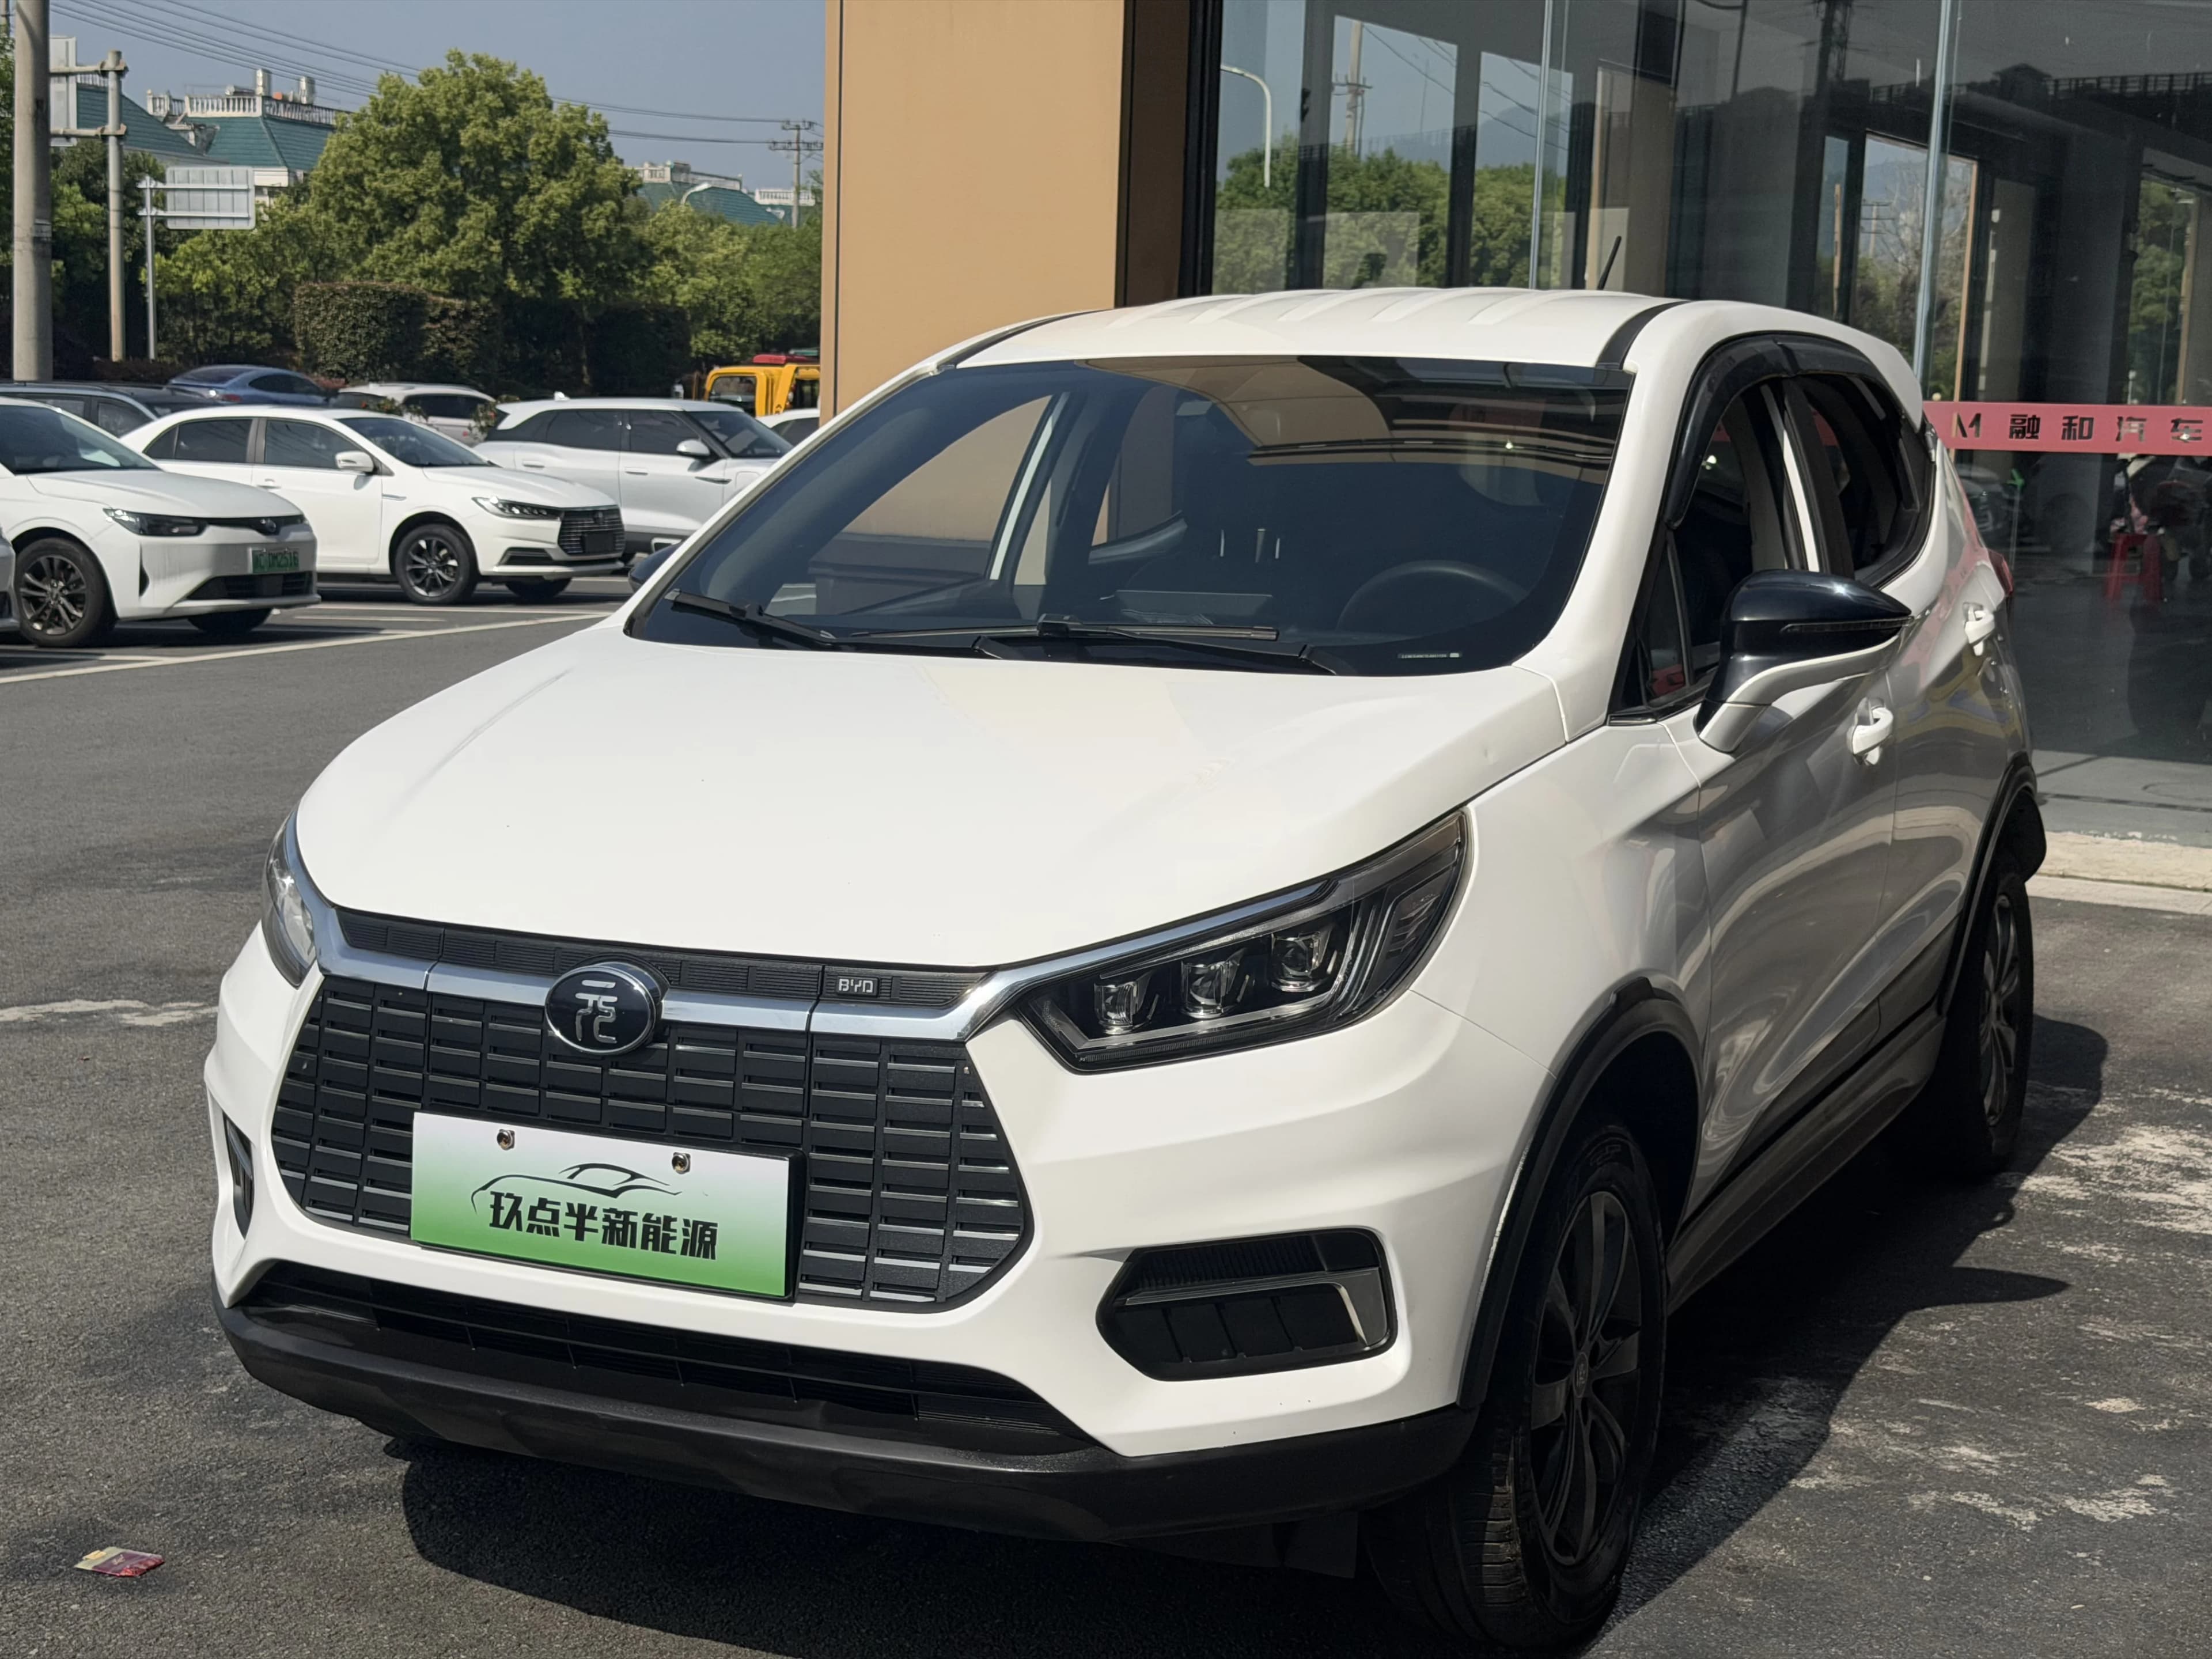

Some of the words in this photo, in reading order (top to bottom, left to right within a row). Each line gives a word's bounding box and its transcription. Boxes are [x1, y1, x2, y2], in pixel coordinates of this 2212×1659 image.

[2009, 414, 2203, 442] 融和汽车
[838, 978, 873, 993] BYD
[489, 1191, 718, 1260] 玖点半新能源
